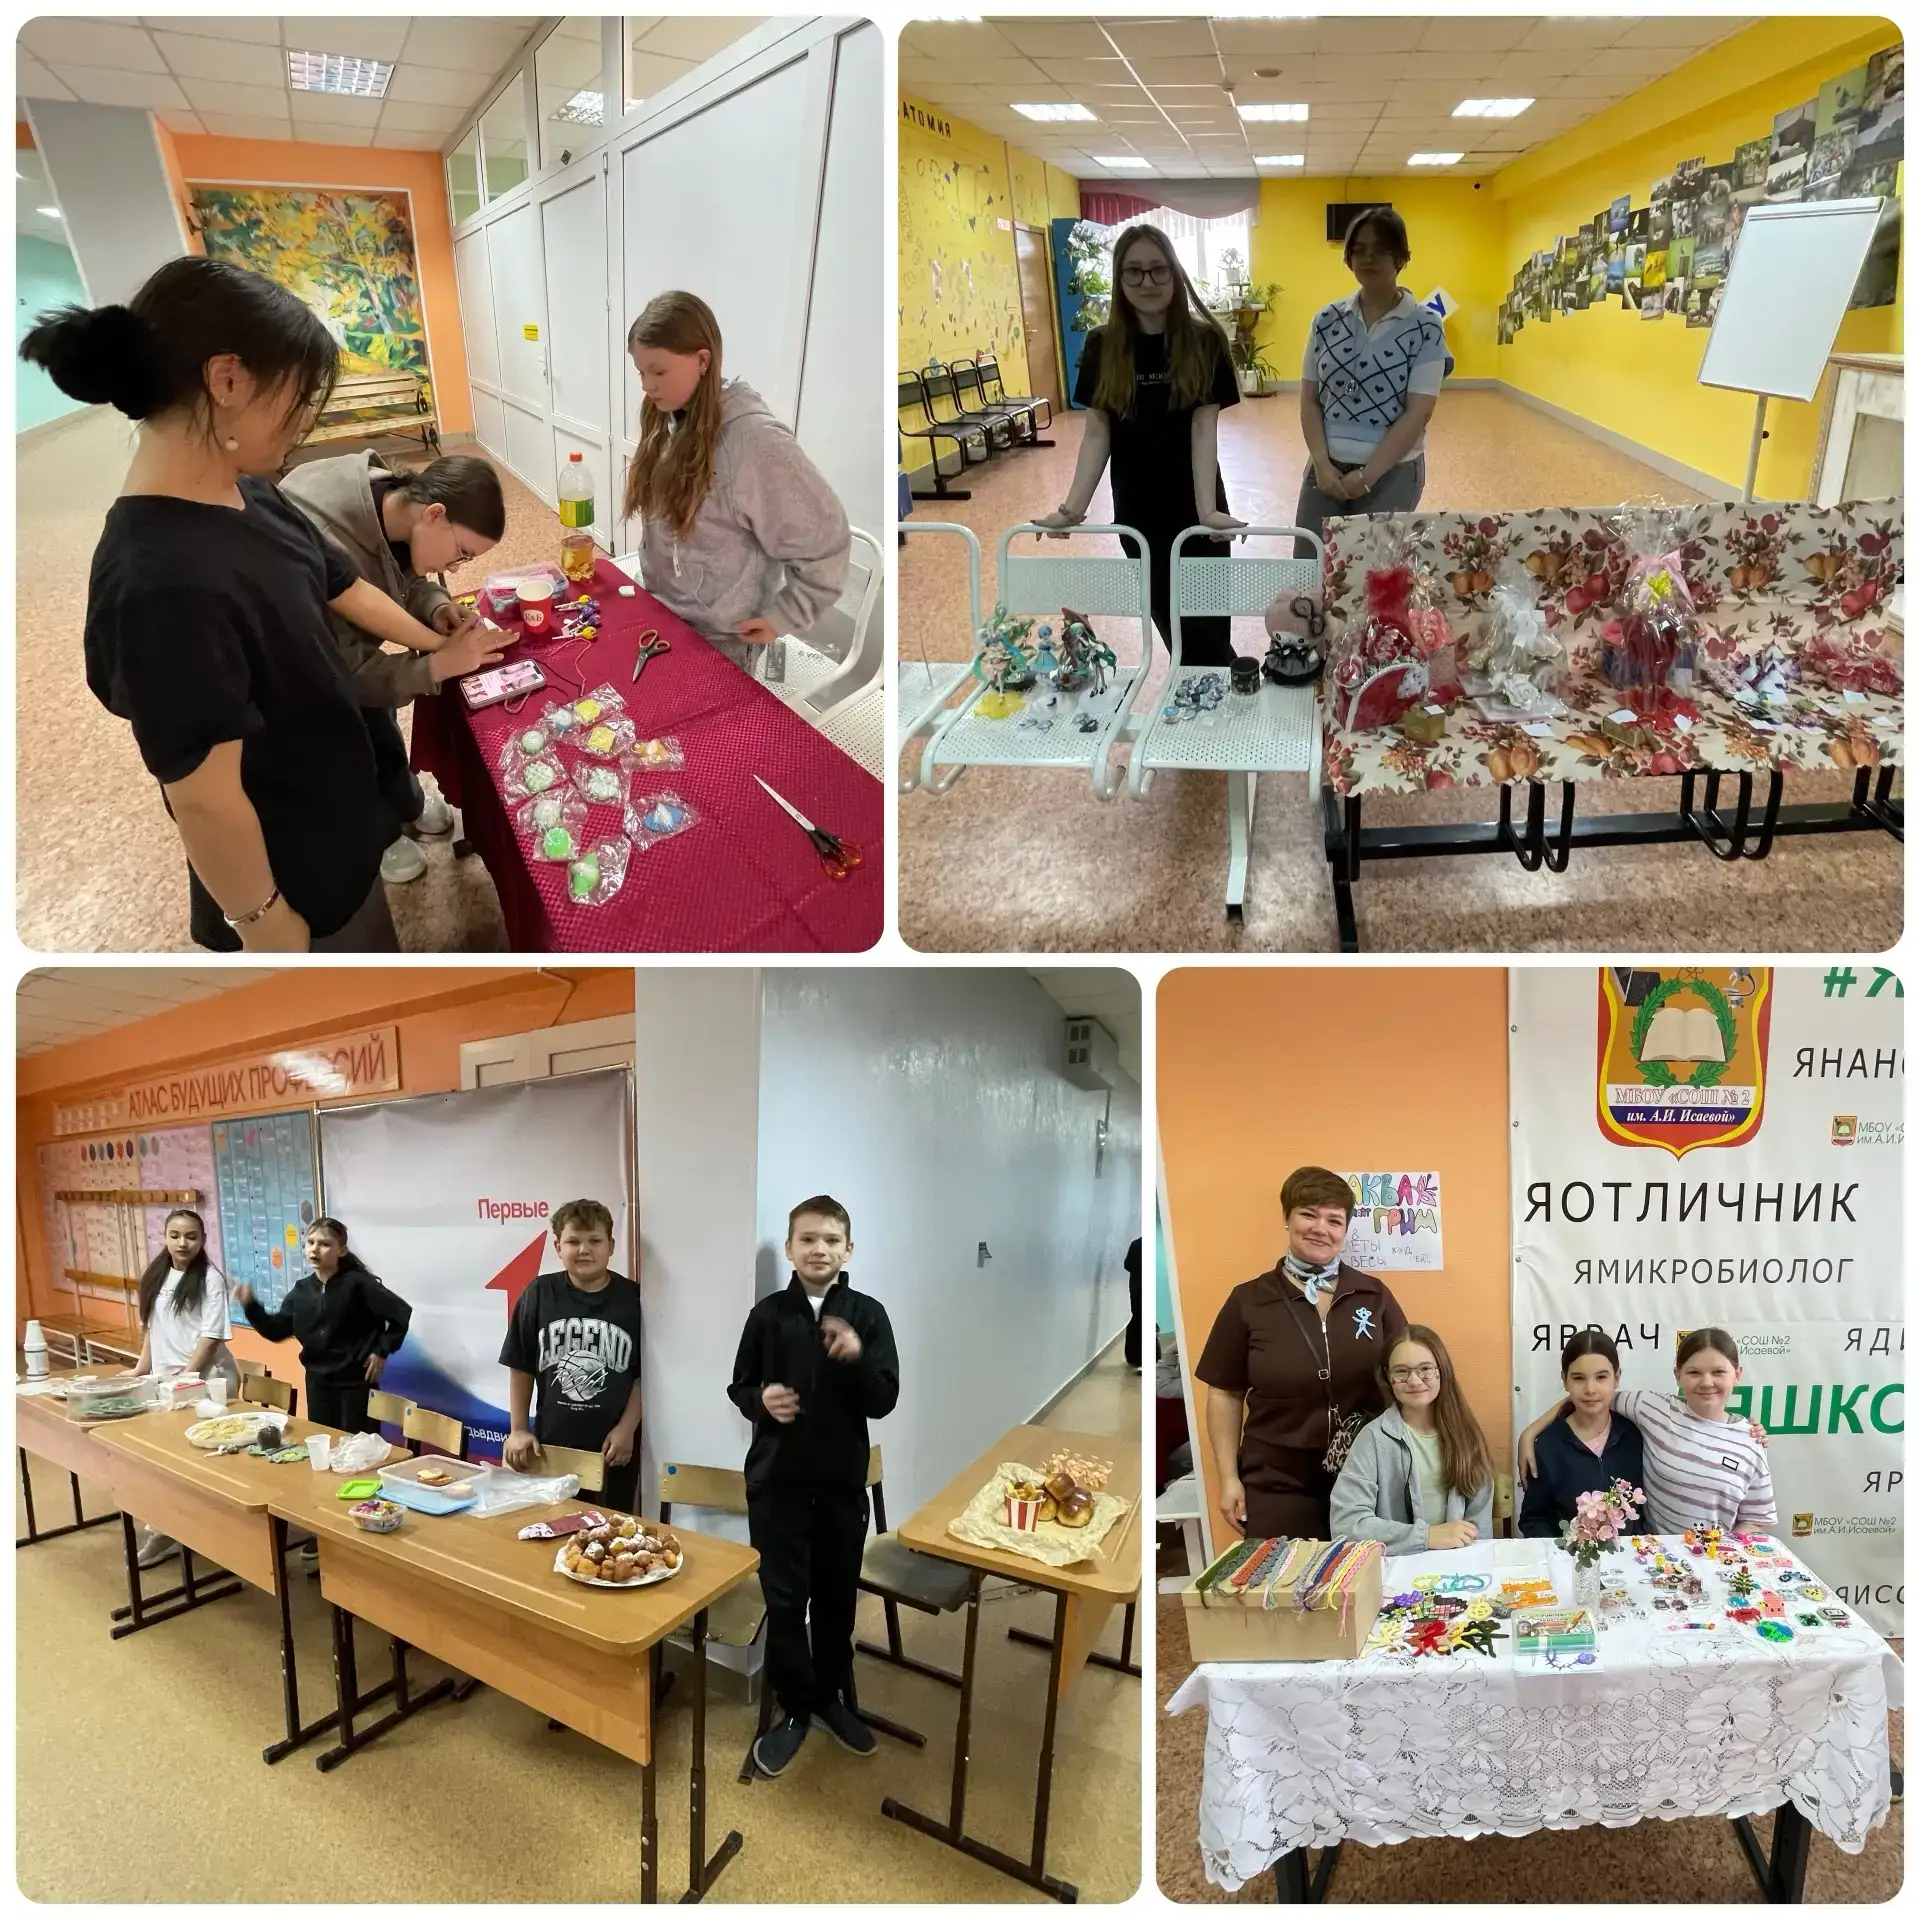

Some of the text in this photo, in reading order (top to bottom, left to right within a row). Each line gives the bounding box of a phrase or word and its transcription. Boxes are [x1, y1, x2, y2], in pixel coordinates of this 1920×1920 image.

[898, 101, 952, 138] АТОМИЯ
[1793, 1047, 1904, 1078] ЯНАН
[128, 1087, 169, 1119] АТЛАС
[170, 1070, 246, 1115] БУДУЩИХ
[1615, 1088, 1750, 1105] МБОУ «СОШ № 2
[1626, 1109, 1736, 1123] им. А.И. Исаевой»
[1858, 1121, 1893, 1133] МБОУ
[478, 1198, 549, 1225] Первые
[1524, 1182, 1859, 1223] ЯОТЛИЧНИК
[1373, 1207, 1438, 1237] ГРИМ
[1573, 1258, 1854, 1285] ЯМИКРОБИОЛОГ
[538, 1317, 633, 1373] LEGEND
[1736, 1335, 1791, 1346] «СОШ №2
[1740, 1345, 1791, 1355] Исаевой»
[1814, 1517, 1844, 1526] МБОУ
[1878, 1516, 1897, 1526] №2
